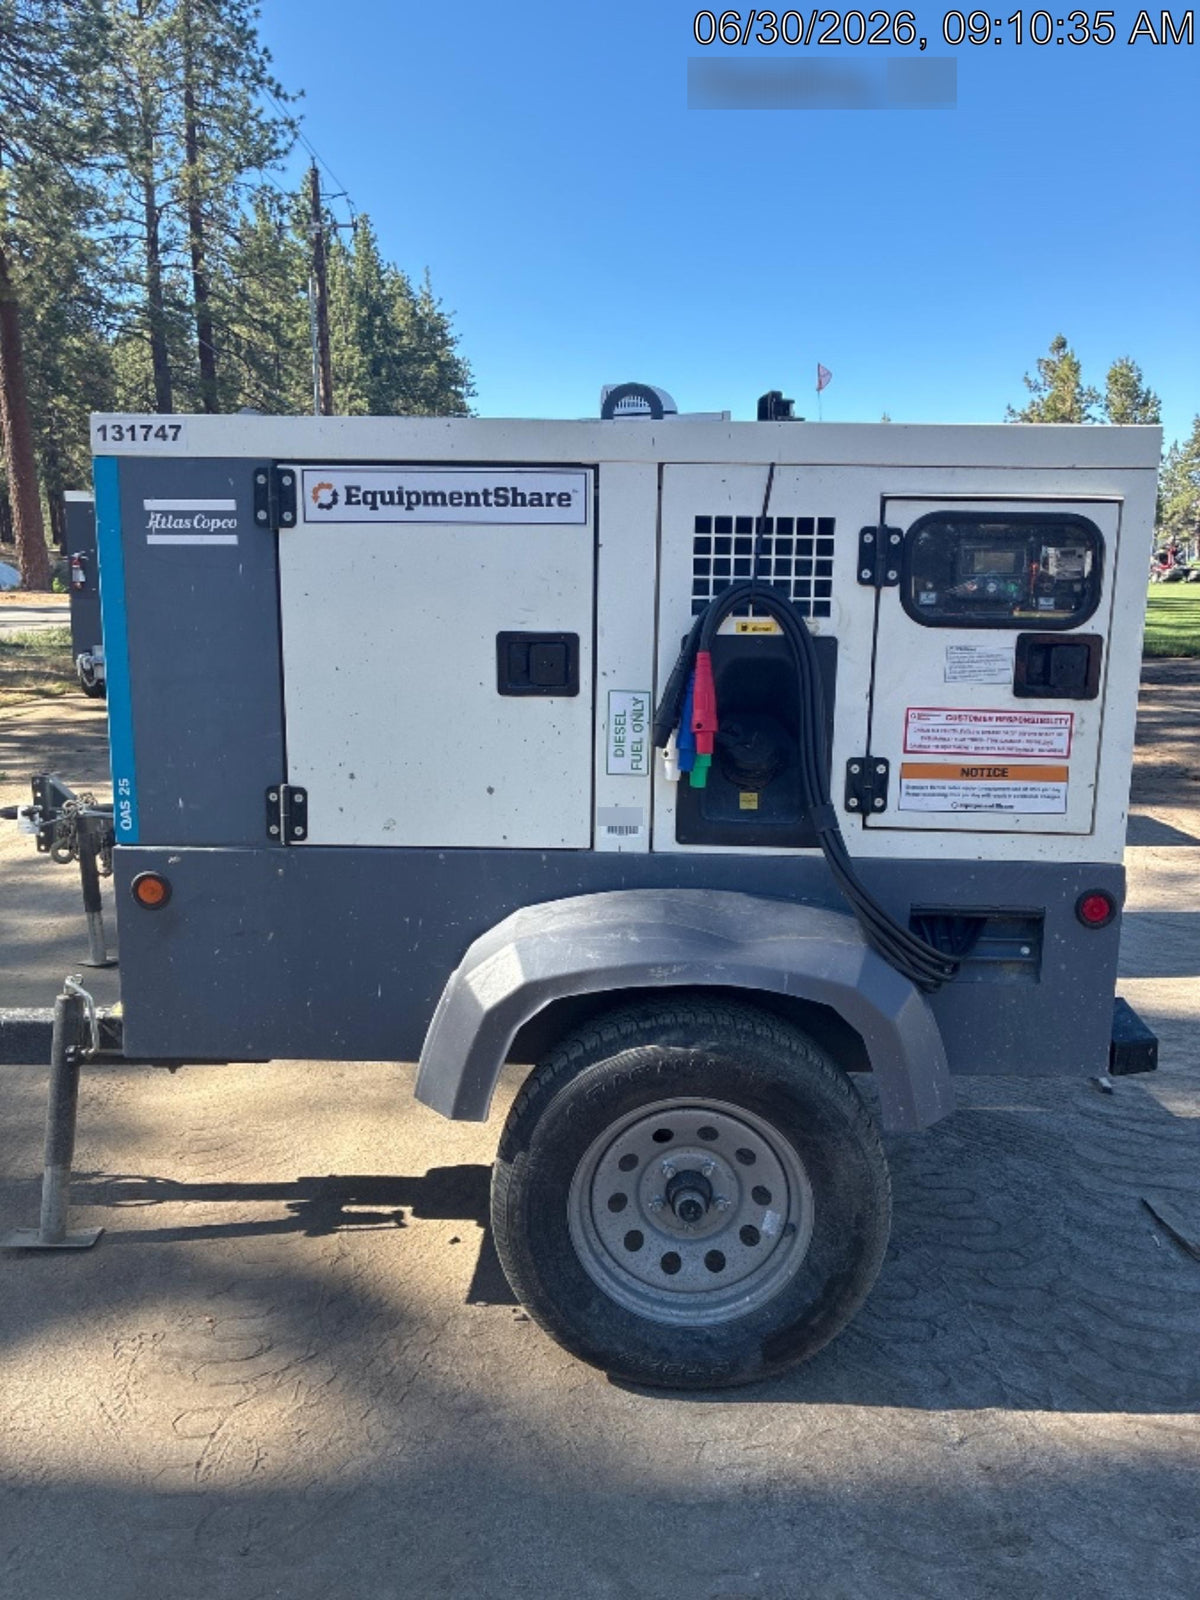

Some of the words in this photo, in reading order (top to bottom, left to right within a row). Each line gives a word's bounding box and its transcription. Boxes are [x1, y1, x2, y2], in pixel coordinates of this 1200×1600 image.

[97, 424, 182, 441] 131747
[344, 485, 572, 511] EquipmentShare
[145, 512, 191, 532] Atlas
[193, 513, 237, 532] Copco
[632, 697, 645, 733] ONLY
[613, 709, 627, 758] DIESEL
[631, 737, 643, 771] FUEL
[960, 767, 1009, 778] NOTICE
[118, 778, 130, 796] 25
